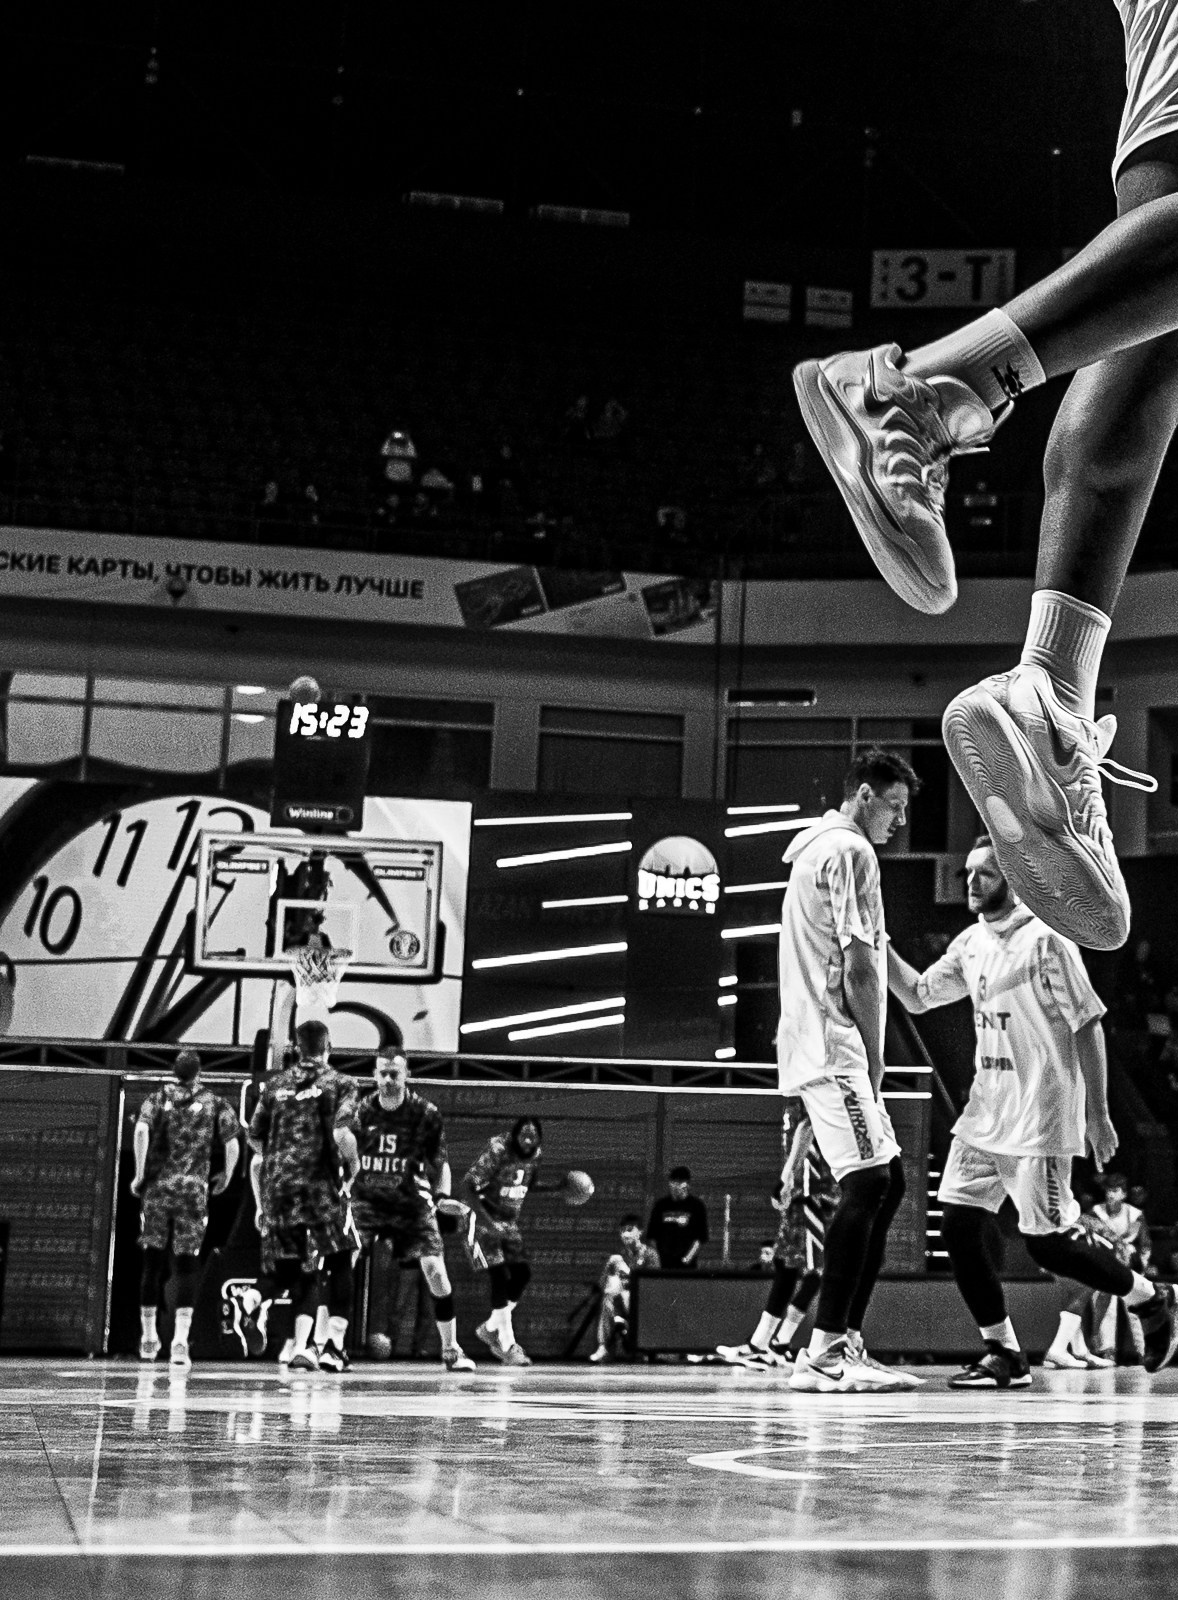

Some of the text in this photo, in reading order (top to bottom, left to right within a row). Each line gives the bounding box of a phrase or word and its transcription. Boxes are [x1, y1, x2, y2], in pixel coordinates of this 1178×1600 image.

[67, 556, 159, 583] КАРТЫ,
[165, 562, 252, 588] ЧТОБЫ
[258, 569, 330, 594] ЖИТЬ
[333, 574, 425, 600] ЛУЧШЕ
[289, 702, 370, 739] 15:23
[92, 812, 148, 888] 11
[637, 869, 721, 902] UNICS
[23, 875, 82, 956] 10
